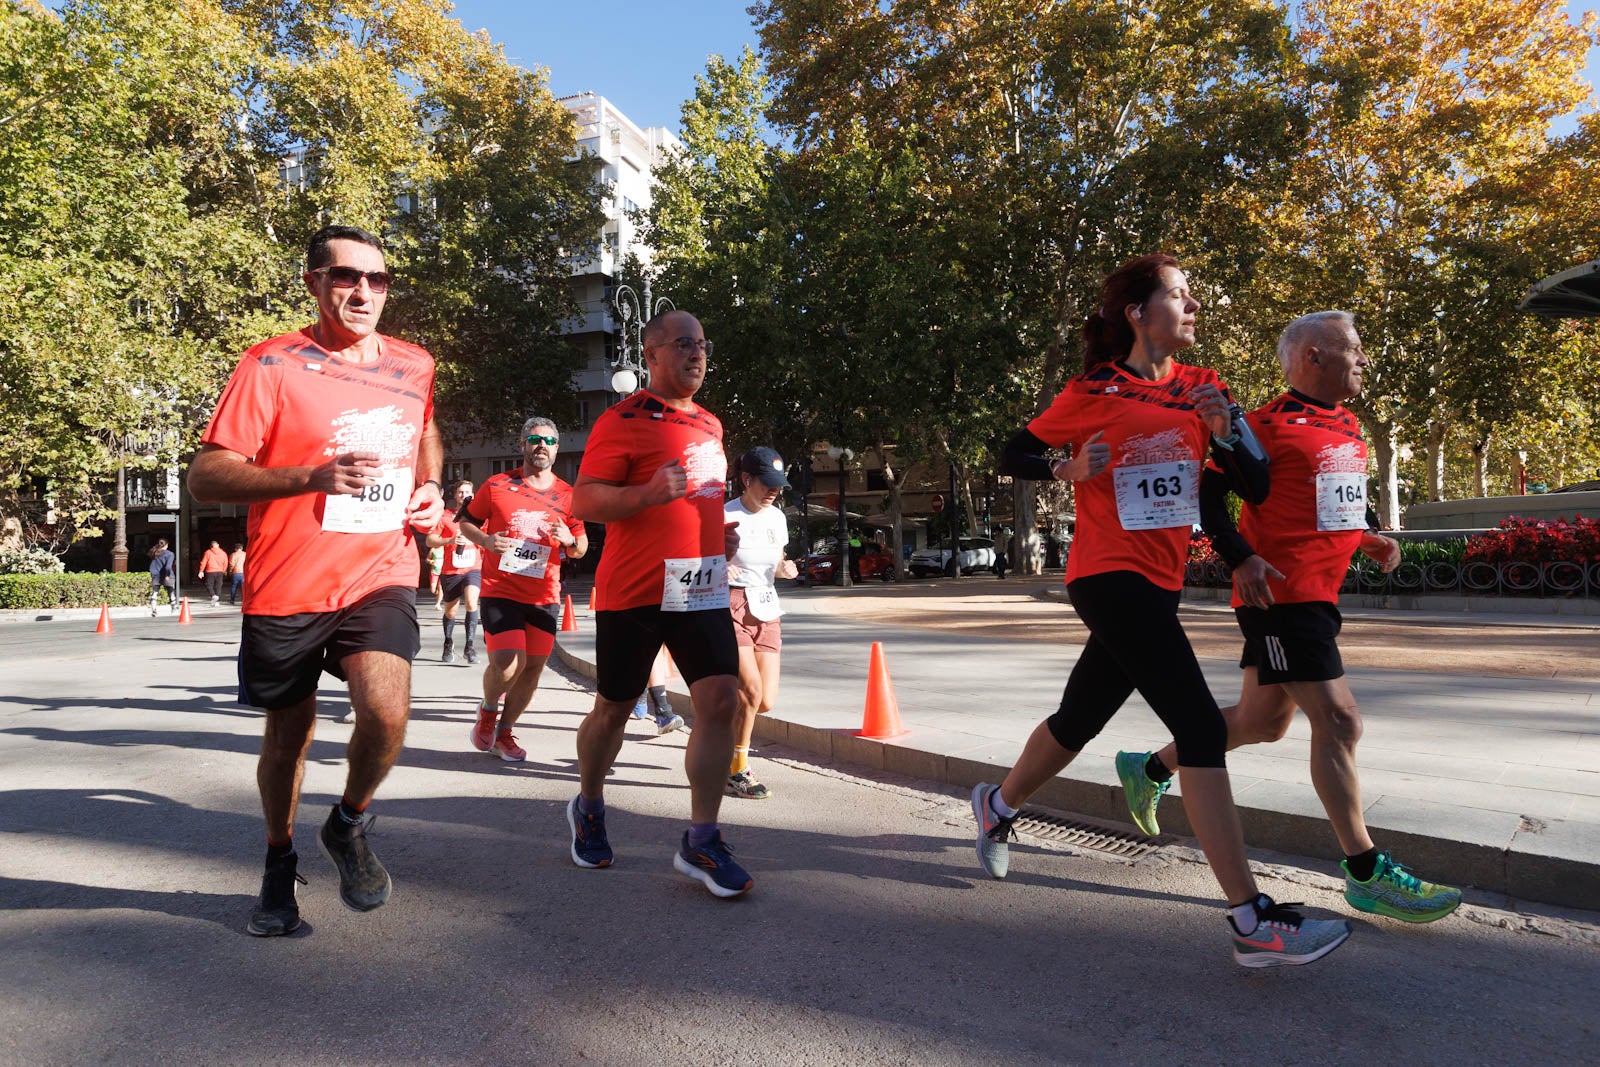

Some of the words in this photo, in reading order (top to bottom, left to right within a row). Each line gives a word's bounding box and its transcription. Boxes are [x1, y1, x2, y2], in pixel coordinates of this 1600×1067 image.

[352, 484, 394, 502] 480
[1137, 475, 1182, 499] 163
[1335, 485, 1362, 503] 164
[514, 547, 538, 561] 546
[680, 568, 712, 586] 411
